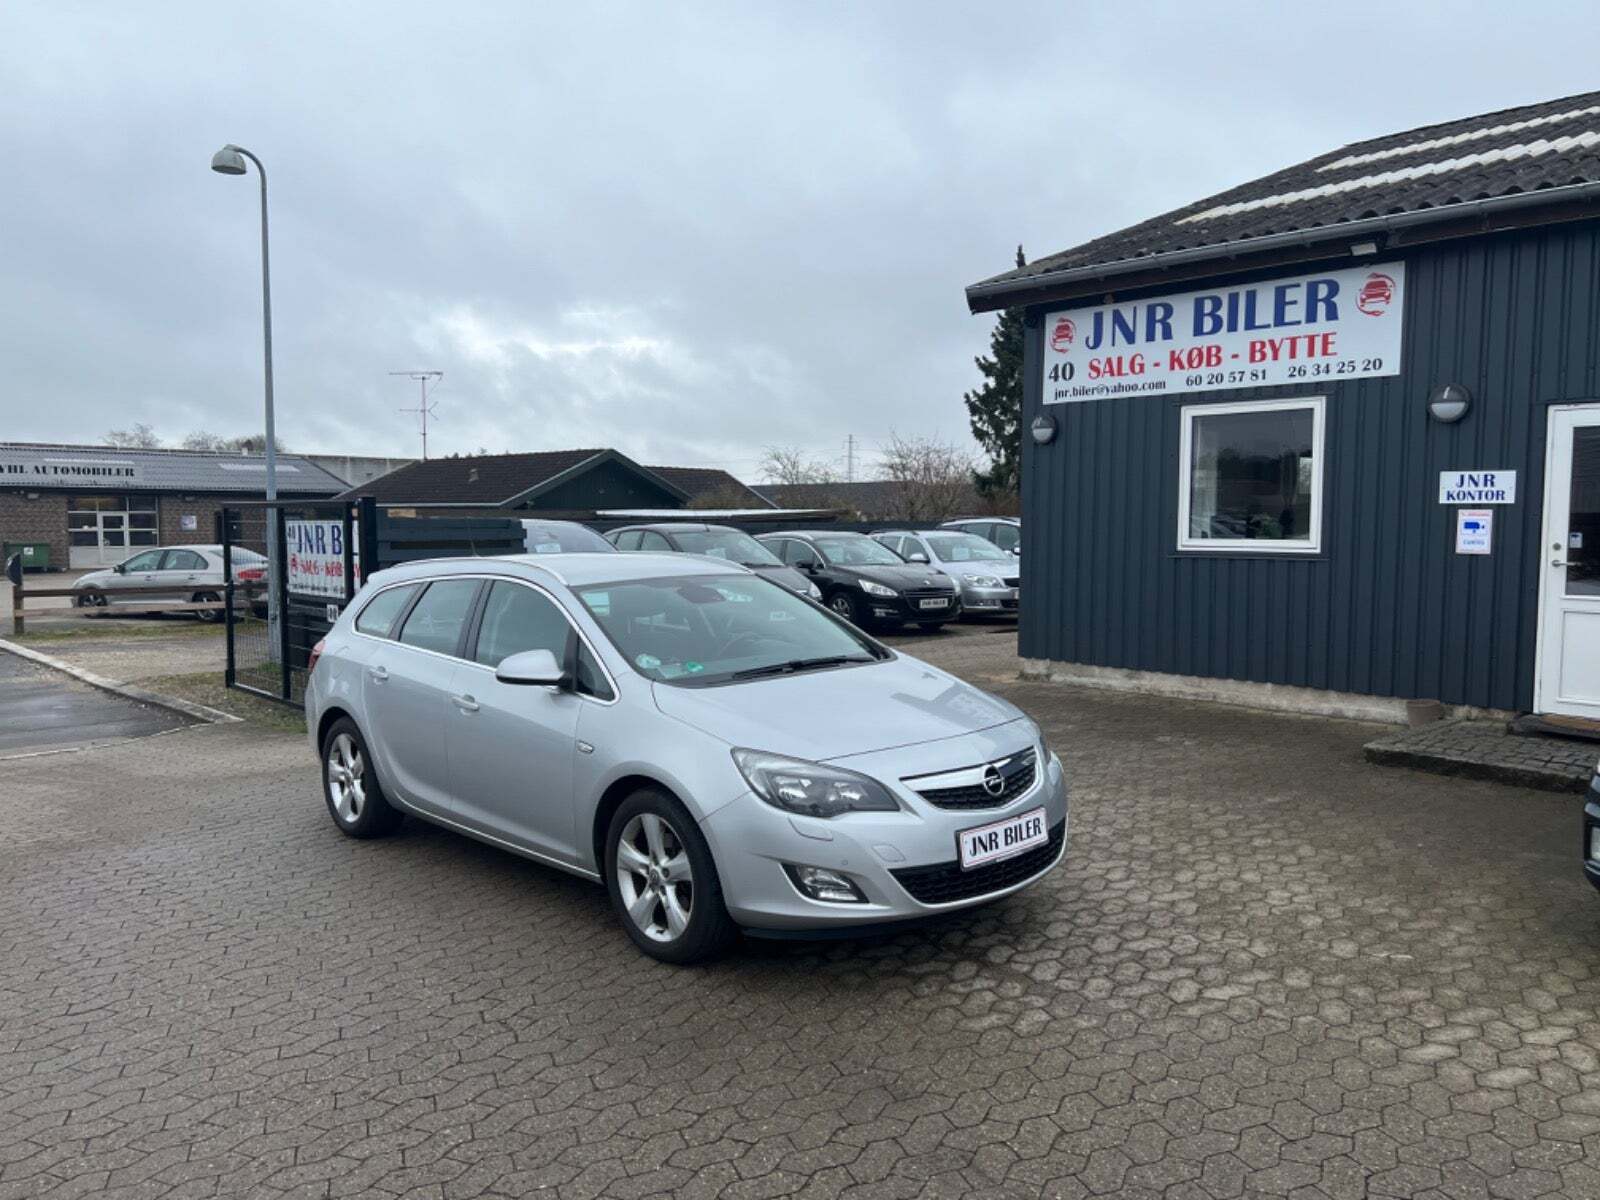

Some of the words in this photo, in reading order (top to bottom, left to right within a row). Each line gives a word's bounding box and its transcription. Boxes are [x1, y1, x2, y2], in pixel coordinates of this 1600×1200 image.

[1085, 302, 1174, 350] JNR
[1192, 279, 1340, 337] BILER
[1088, 353, 1145, 380] SALG
[1169, 344, 1222, 372] KØB
[1249, 332, 1338, 364] BYTTE
[1048, 361, 1075, 382] 40
[1186, 374, 1202, 387] 60
[1207, 373, 1224, 385] 20
[1228, 371, 1245, 383] 57
[1250, 369, 1267, 381] 81
[1288, 364, 1307, 378] 26
[1311, 362, 1330, 376] 34
[1336, 360, 1356, 374] 25
[1362, 358, 1383, 371] 20
[1054, 380, 1167, 400] jnr.biler@yahoo.com
[32, 465, 135, 477] AUTOMOBILER
[1456, 473, 1496, 488] JNR
[1446, 490, 1506, 501] KONTOR
[297, 524, 326, 554] JNR
[969, 831, 999, 857] JNR
[1004, 817, 1042, 847] BILER
